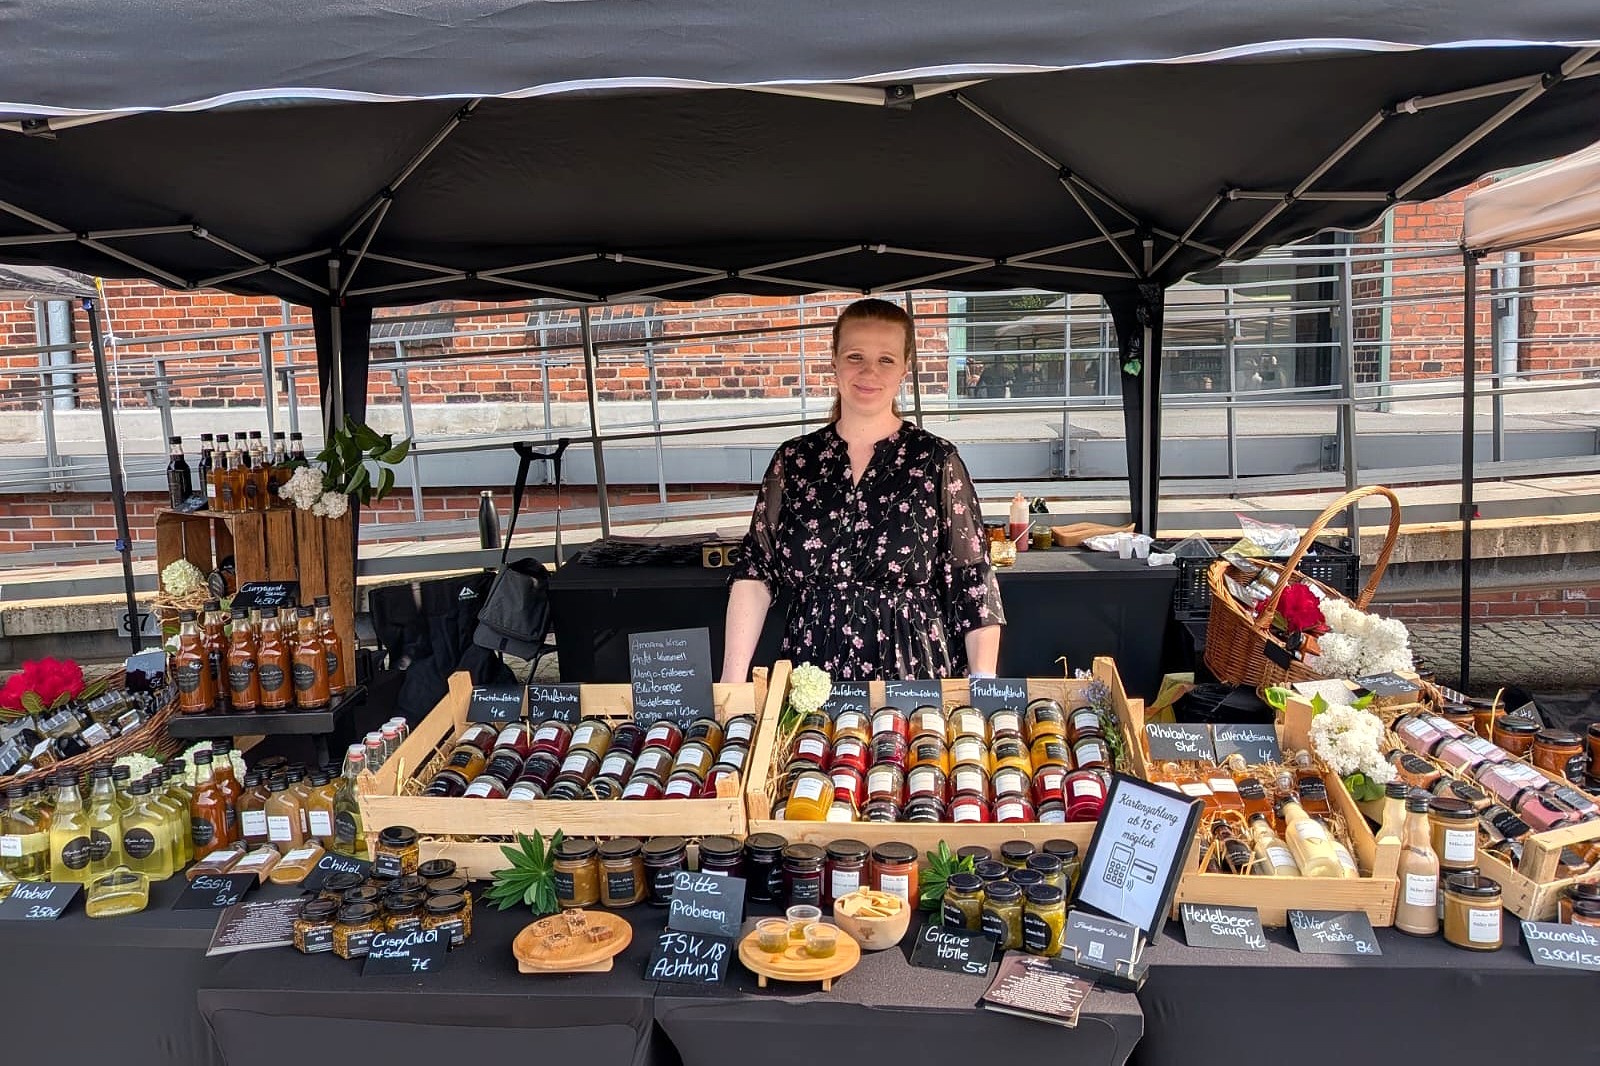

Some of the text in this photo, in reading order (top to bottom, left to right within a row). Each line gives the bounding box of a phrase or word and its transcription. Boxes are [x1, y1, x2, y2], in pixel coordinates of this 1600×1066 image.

[1174, 741, 1199, 753] Shot
[1119, 793, 1179, 827] Kartenzahlung
[1127, 816, 1140, 826] ab
[1139, 818, 1152, 831] 15
[1121, 831, 1156, 849] möglich
[191, 876, 233, 894] Essig
[675, 872, 722, 895] Bitte
[671, 899, 726, 924] Probieren
[1183, 903, 1255, 927] Heidelbeer-
[925, 926, 970, 948] Grüne
[1211, 924, 1247, 938] Sirup
[1521, 922, 1600, 946] Baconsalz
[660, 933, 727, 961] FSK 18
[1245, 934, 1266, 950] 4€
[937, 944, 969, 961] Hölle
[411, 958, 431, 972] 7€
[652, 957, 719, 981] Achtung
